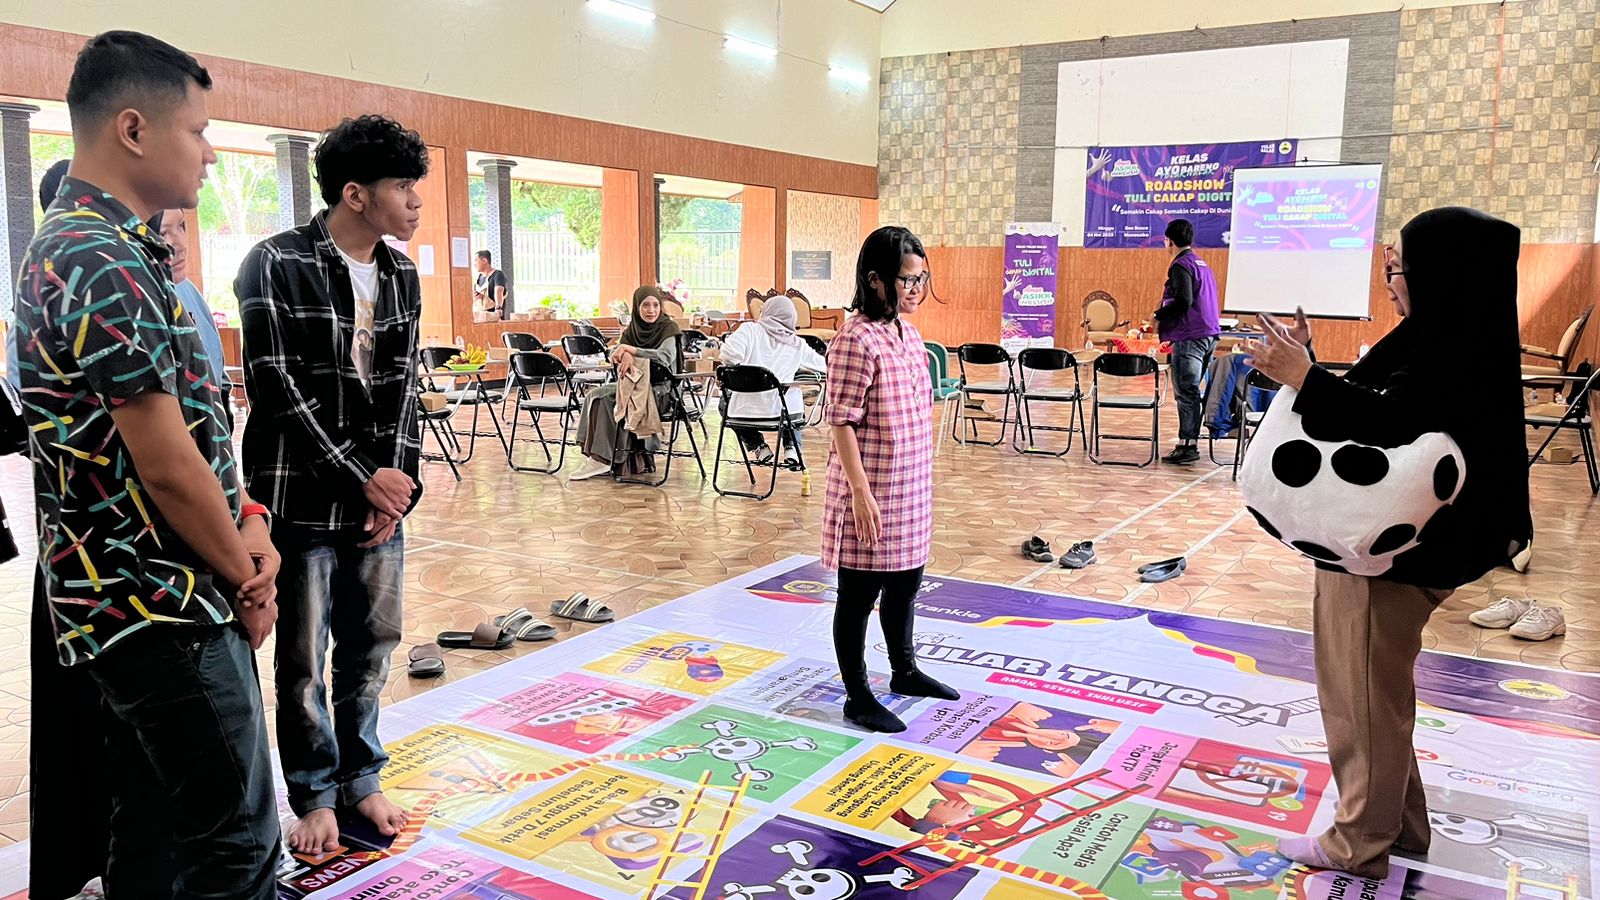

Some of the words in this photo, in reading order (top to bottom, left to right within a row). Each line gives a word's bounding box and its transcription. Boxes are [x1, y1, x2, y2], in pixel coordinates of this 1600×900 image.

[1171, 153, 1208, 165] KELAS
[1155, 166, 1180, 177] AYO
[1145, 179, 1225, 191] ROADSHOW
[1124, 193, 1151, 203] TULI
[1154, 193, 1195, 203] CAKAP
[1198, 192, 1233, 202] DIGIT
[1013, 259, 1032, 267] TULI
[1022, 267, 1055, 277] DIGITAL
[917, 641, 1050, 676] ULAR
[1058, 664, 1291, 728] TANGGA
[376, 764, 417, 782] Haru
[536, 778, 595, 808] Sebelum
[1446, 770, 1574, 802] Google.org
[497, 806, 542, 828] Sebar
[539, 792, 593, 819] Tunggu
[532, 804, 598, 839] Informasi
[495, 823, 538, 844] Detik
[1051, 834, 1080, 858] Apa?
[1072, 842, 1105, 869] Media
[350, 875, 404, 900] Onlin
[413, 869, 474, 900] Conto
